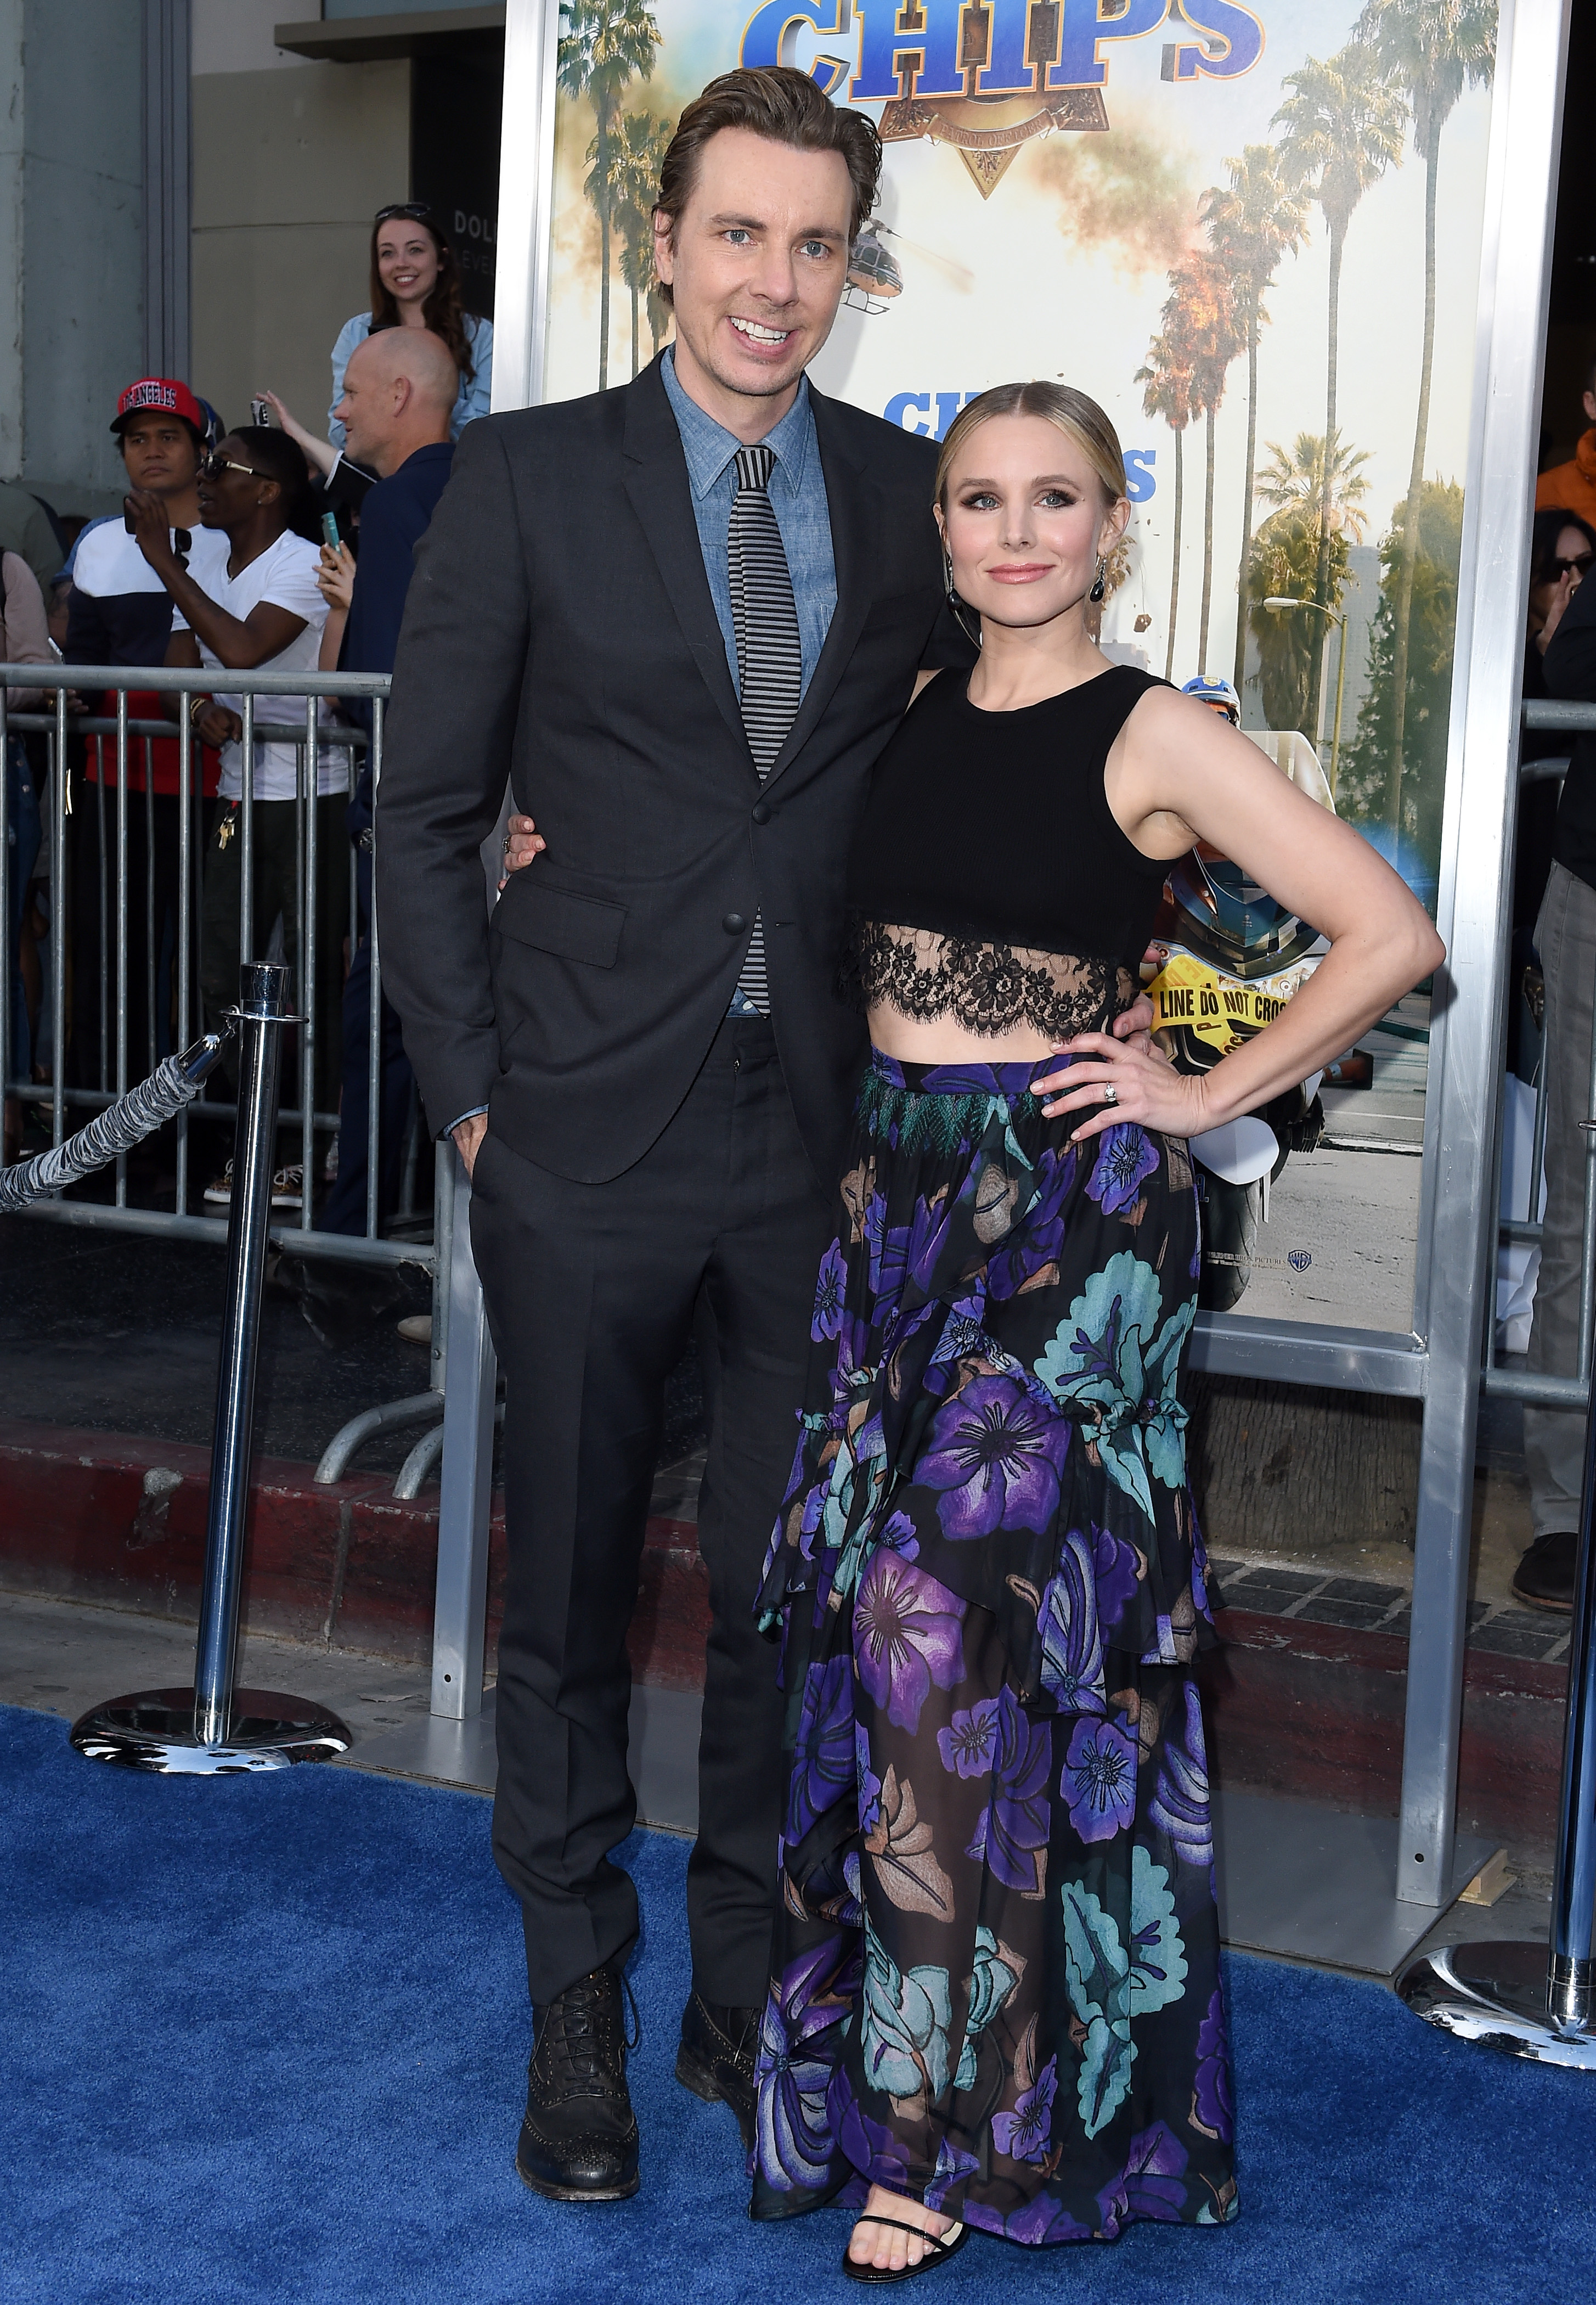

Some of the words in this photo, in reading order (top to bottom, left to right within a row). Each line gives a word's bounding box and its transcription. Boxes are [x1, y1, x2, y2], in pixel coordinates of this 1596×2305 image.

[738, 0, 1265, 103] CHIPS
[939, 124, 985, 147] PATROL
[989, 119, 1043, 147] OFFICER
[455, 210, 497, 243] DOL
[134, 385, 177, 409] ANGELES
[1160, 989, 1195, 1019] LINE
[1200, 991, 1219, 1016] DO
[1223, 991, 1249, 1016] NOT
[1255, 1257, 1287, 1265] PICTURES
